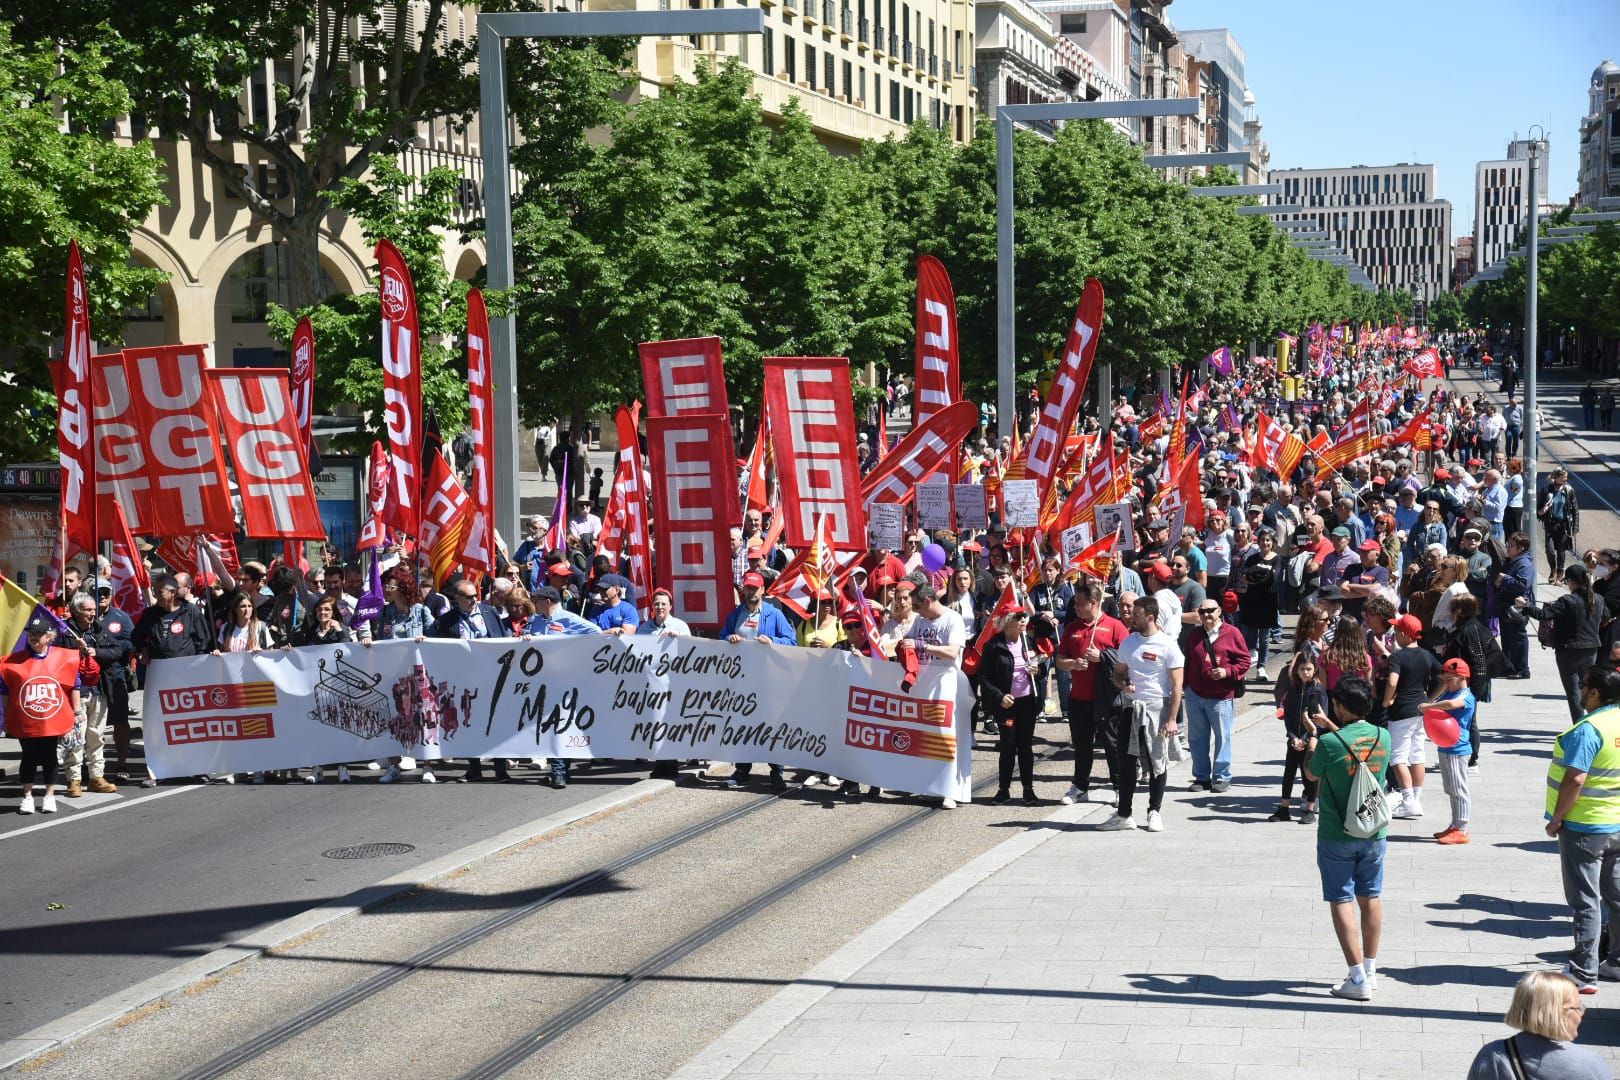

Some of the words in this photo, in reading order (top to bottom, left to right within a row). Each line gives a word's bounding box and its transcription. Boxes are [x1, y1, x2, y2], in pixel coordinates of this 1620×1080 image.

[137, 354, 218, 527] UGT
[219, 375, 305, 532] UGT
[4, 470, 15, 485] 35
[20, 470, 30, 485] 40
[10, 508, 52, 521] Dewar's
[663, 428, 719, 624] CCOO
[592, 643, 654, 675] Subir
[26, 683, 57, 699] UGT
[162, 689, 207, 711] UGT
[514, 682, 531, 696] DE
[612, 680, 672, 715] bajar
[680, 688, 757, 717] precios
[850, 692, 919, 720] CCOO
[169, 719, 238, 741] CCOO
[565, 735, 591, 748] 2023
[631, 711, 723, 750] repartir
[719, 716, 828, 757] beneficios
[849, 723, 891, 748] UGT
